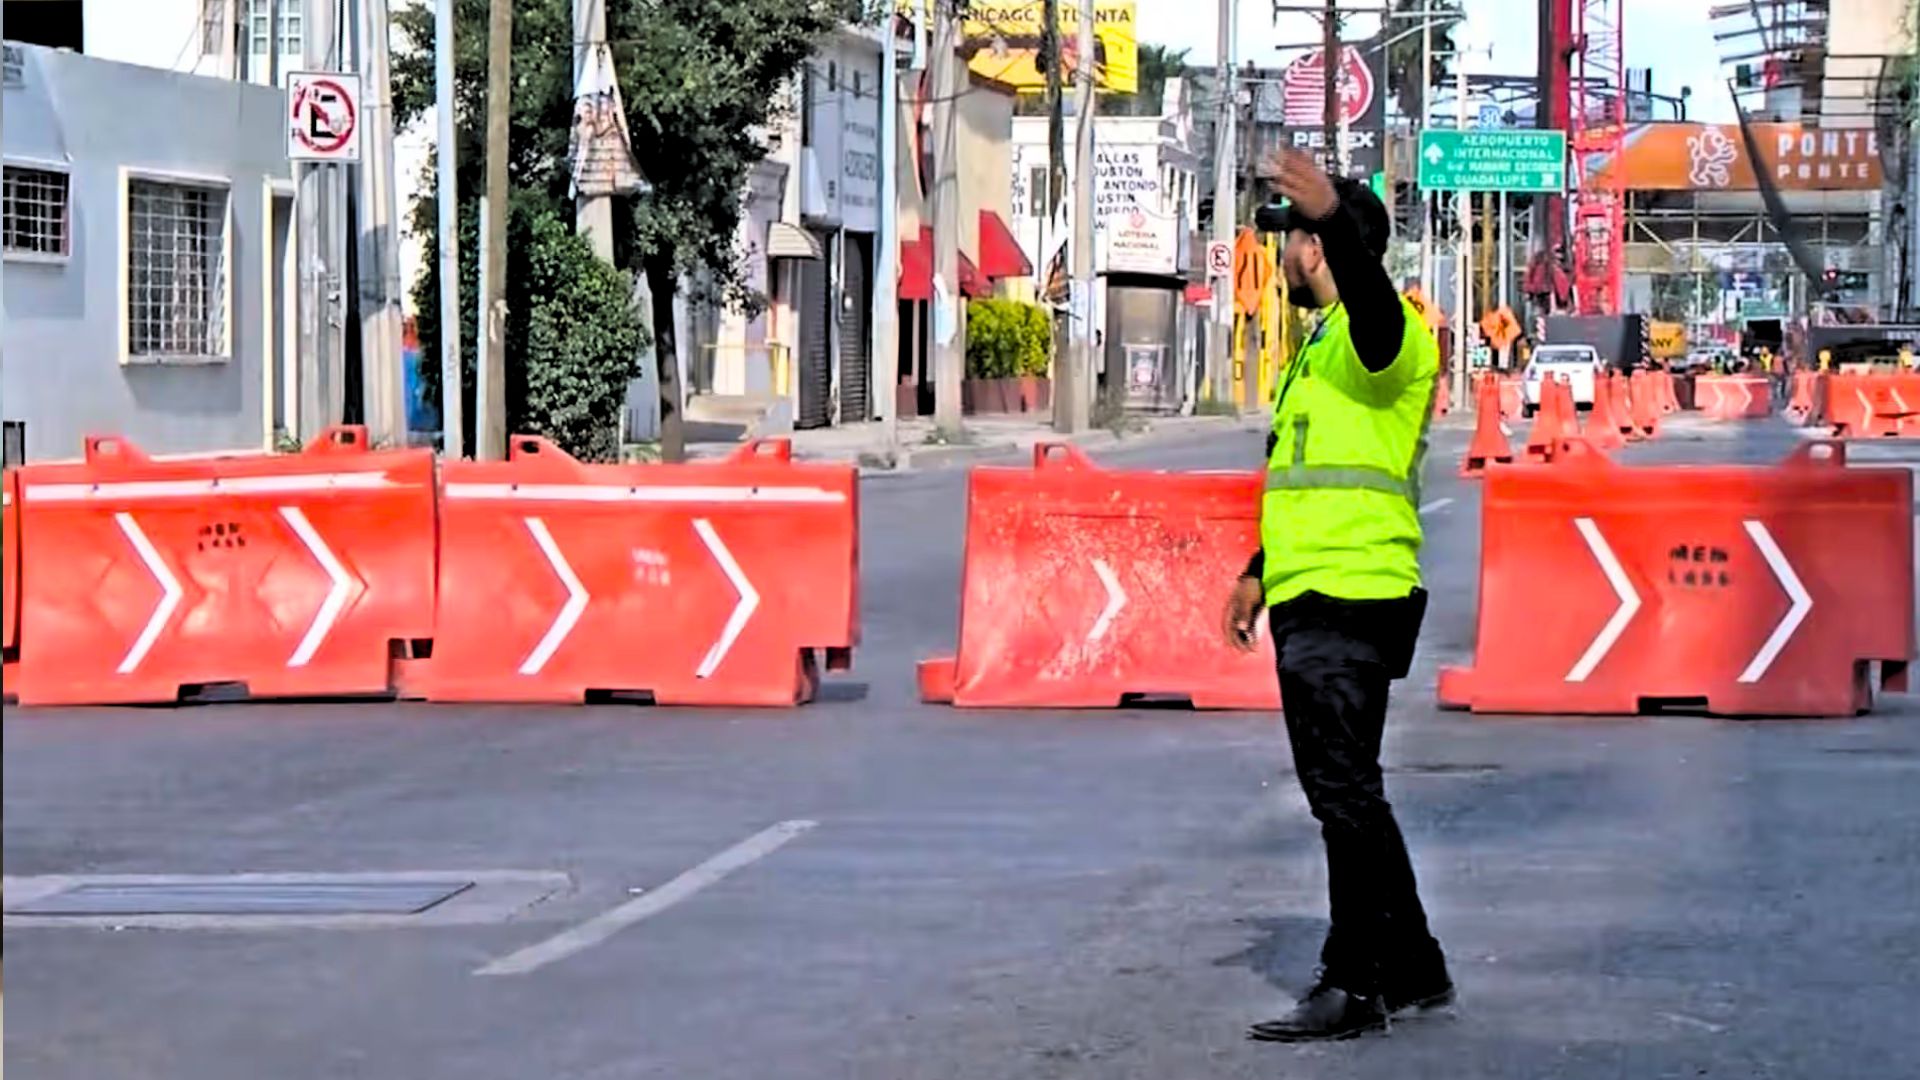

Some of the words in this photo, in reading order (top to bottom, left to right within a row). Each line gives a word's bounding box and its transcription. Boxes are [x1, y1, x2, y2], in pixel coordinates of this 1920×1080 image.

[1293, 131, 1375, 148] PEEX
[1461, 135, 1550, 146] AEROPUERTO
[1096, 153, 1139, 164] ALLAS
[1453, 147, 1555, 159] INTERNACIONAL
[1103, 180, 1158, 191] ANTONIO
[1453, 174, 1529, 186] GUADALUPE
[1096, 193, 1136, 203] USTIN
